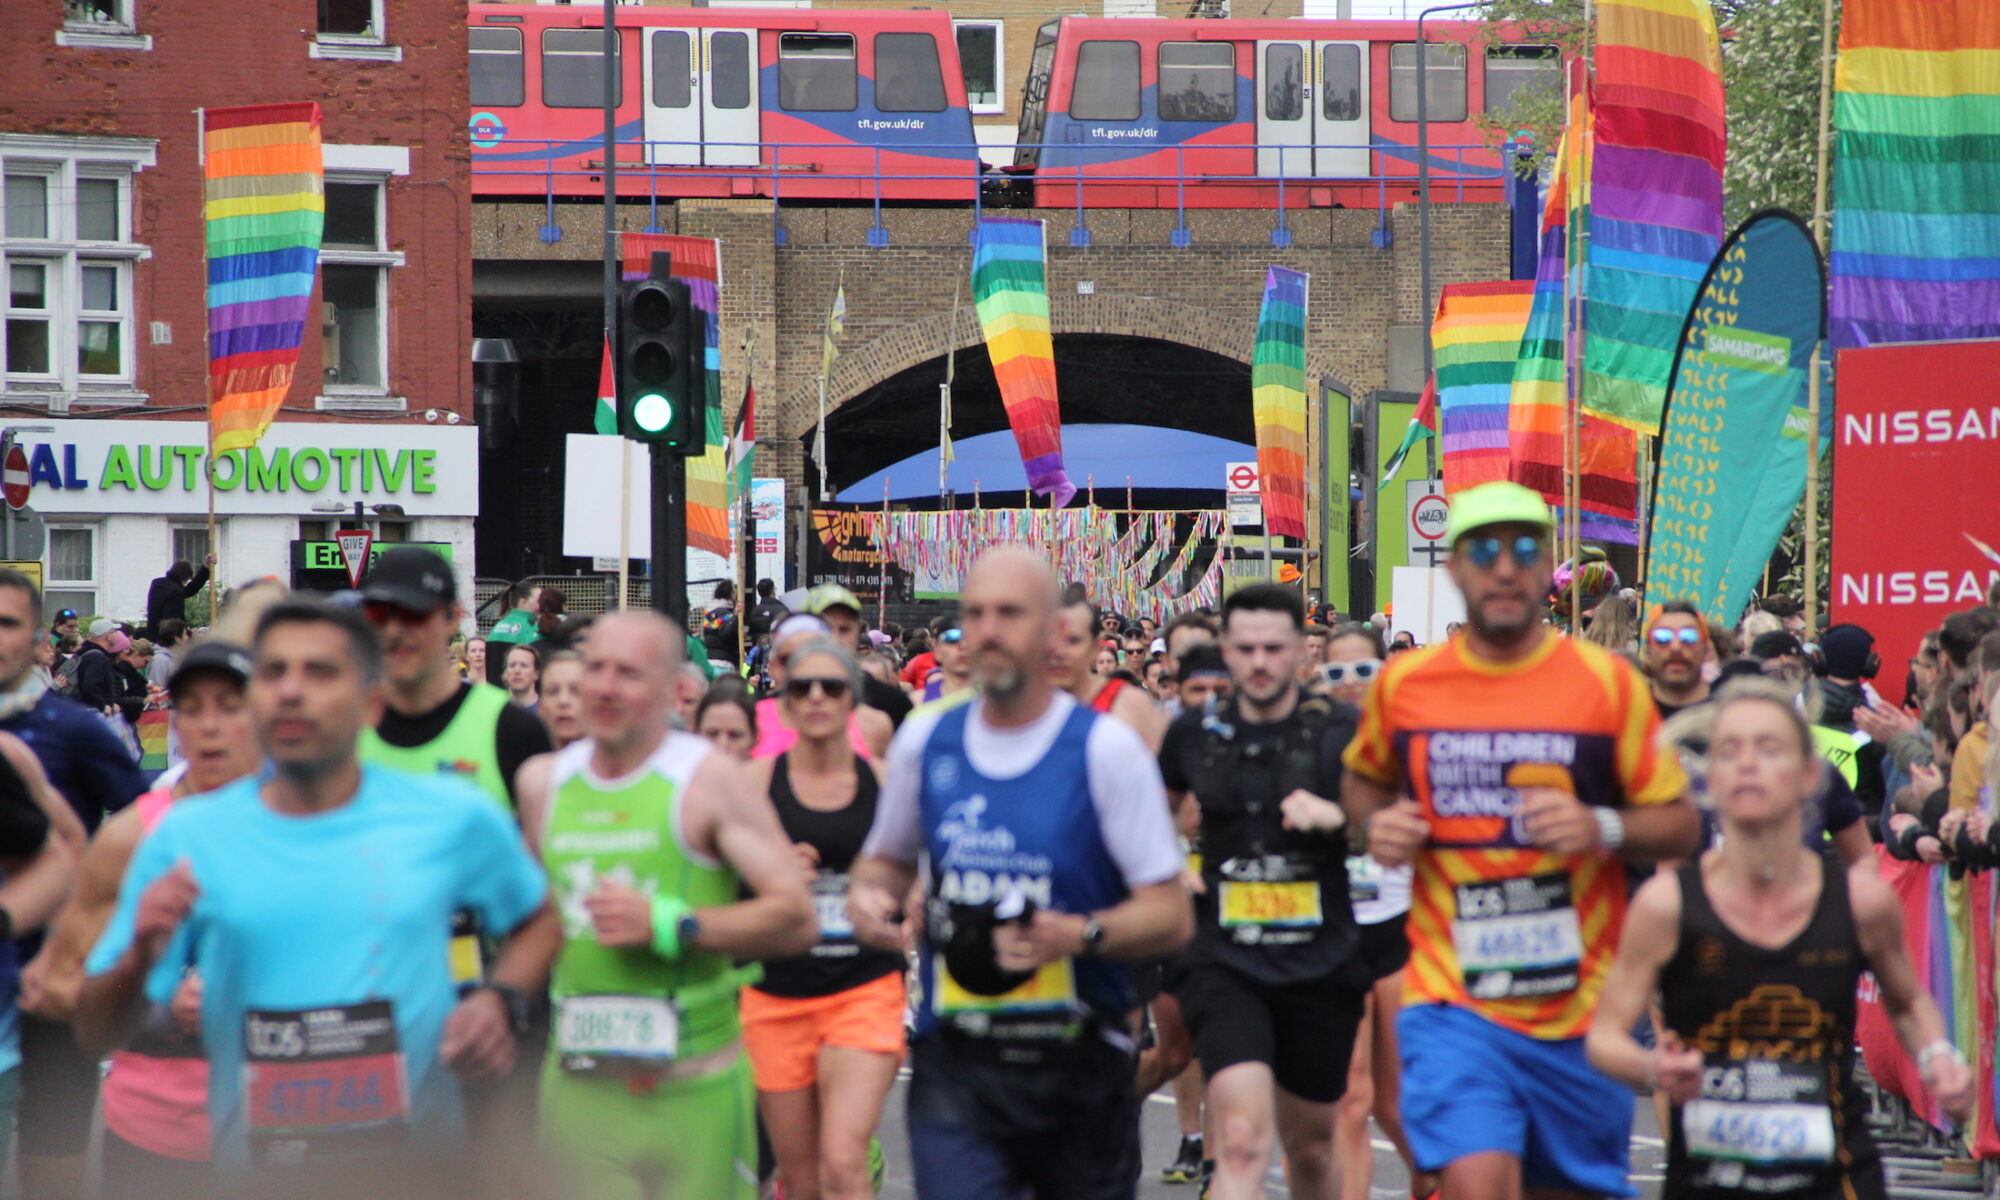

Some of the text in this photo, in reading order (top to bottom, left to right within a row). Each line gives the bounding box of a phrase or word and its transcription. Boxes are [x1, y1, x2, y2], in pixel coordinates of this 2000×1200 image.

[857, 119, 925, 130] tfl.gov.uk/dlr
[1092, 128, 1159, 139] tfl.gov.uk/dlr
[1708, 334, 1787, 367] SAMARITANS
[98, 444, 437, 494] AUTOMOTIVE
[343, 537, 364, 550] GIVE
[347, 553, 361, 561] WAY
[1841, 570, 2000, 606] NISSA
[1429, 732, 1576, 766] CHILDREN
[1429, 763, 1502, 787] WITH
[1432, 785, 1522, 818] CANC
[1457, 884, 1504, 918] tcs
[249, 1012, 305, 1057] tcs
[264, 1073, 384, 1118] 47744
[1702, 1066, 1746, 1100] cs
